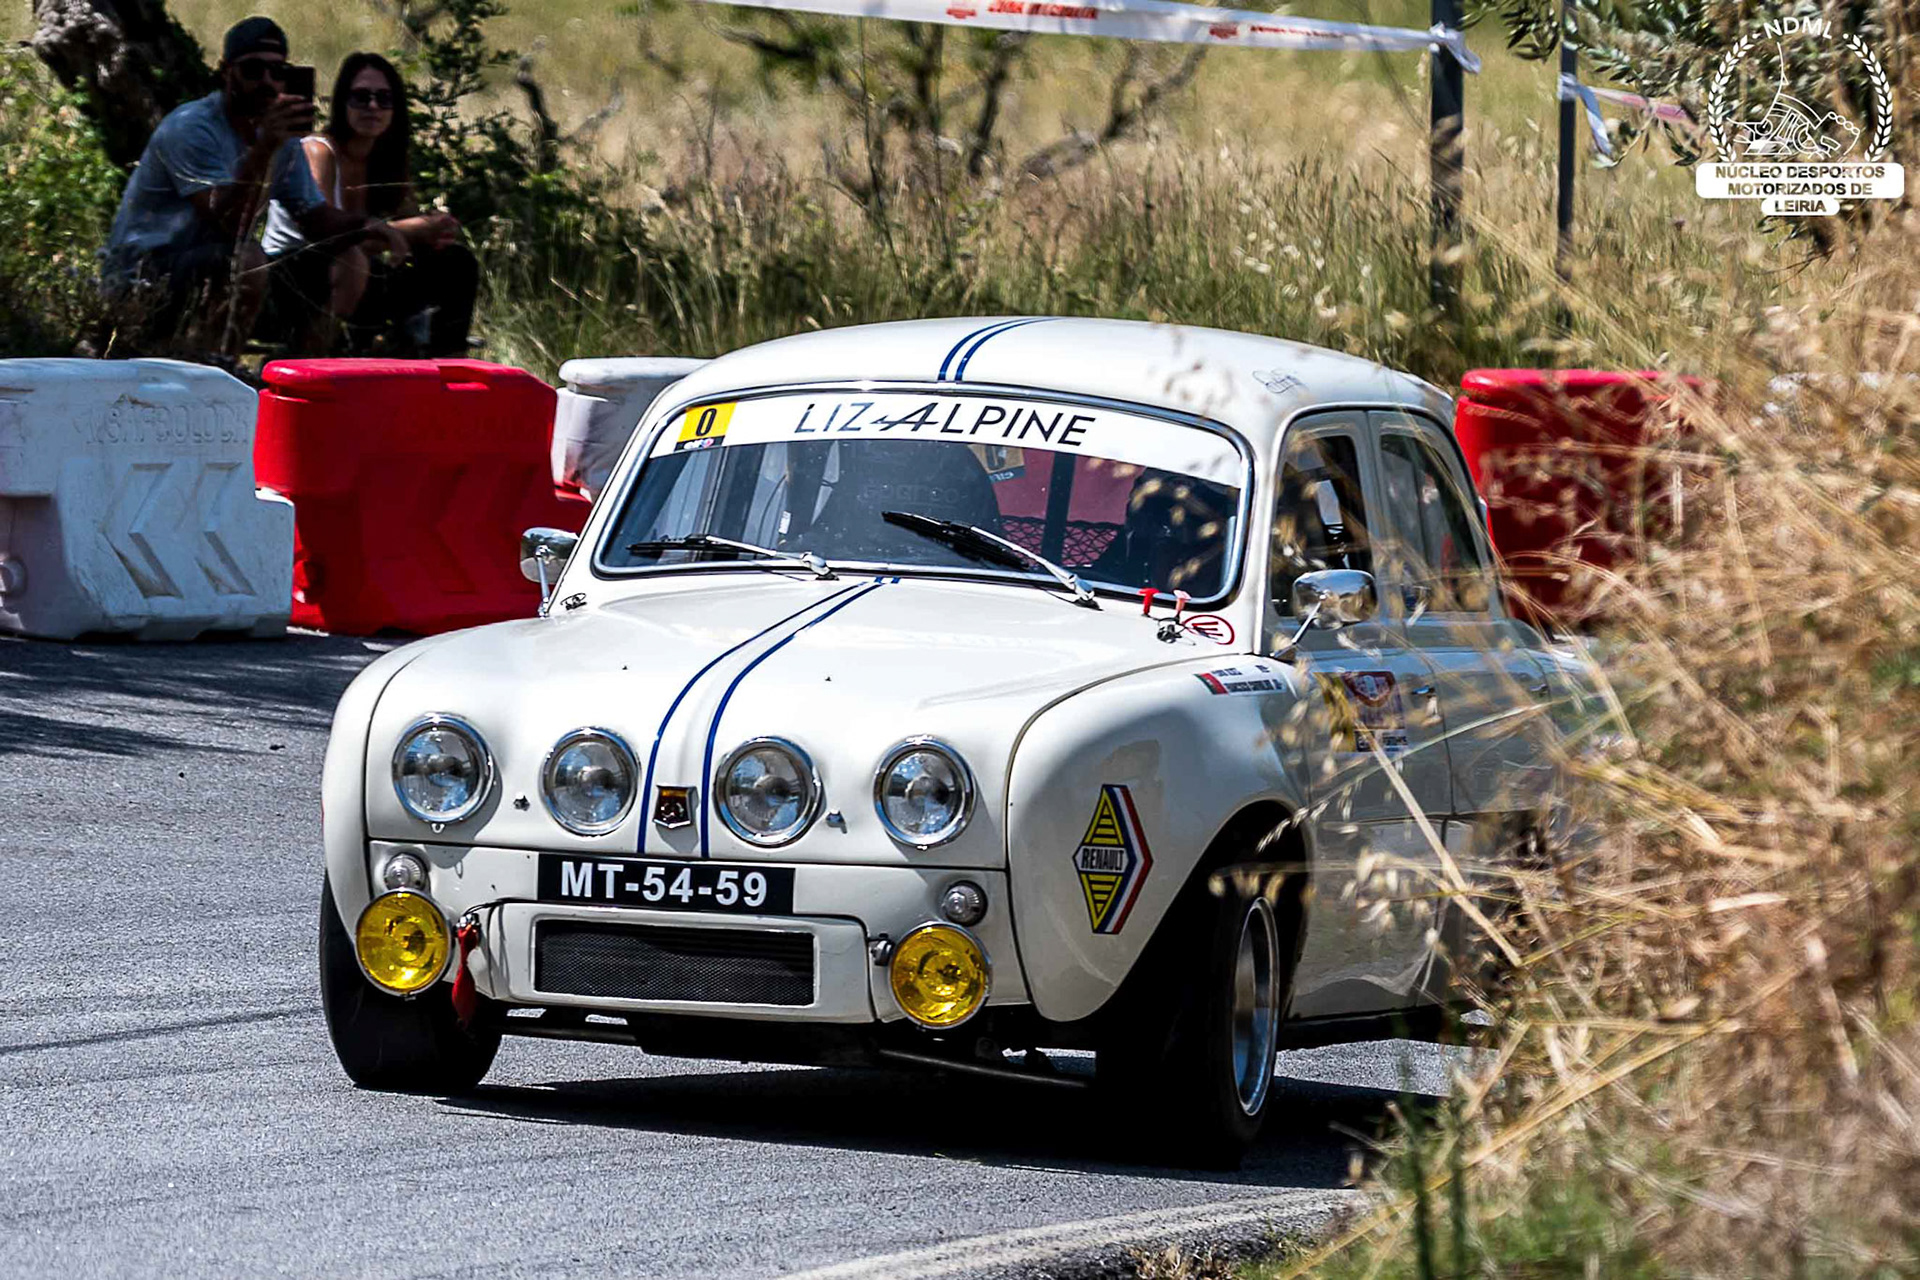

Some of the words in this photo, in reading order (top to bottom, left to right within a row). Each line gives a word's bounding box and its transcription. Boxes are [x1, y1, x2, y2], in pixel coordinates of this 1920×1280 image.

[695, 408, 718, 437] 0
[794, 402, 876, 434] LIZ
[1081, 847, 1124, 871] RENAULT
[561, 860, 767, 907] MT-54-59
